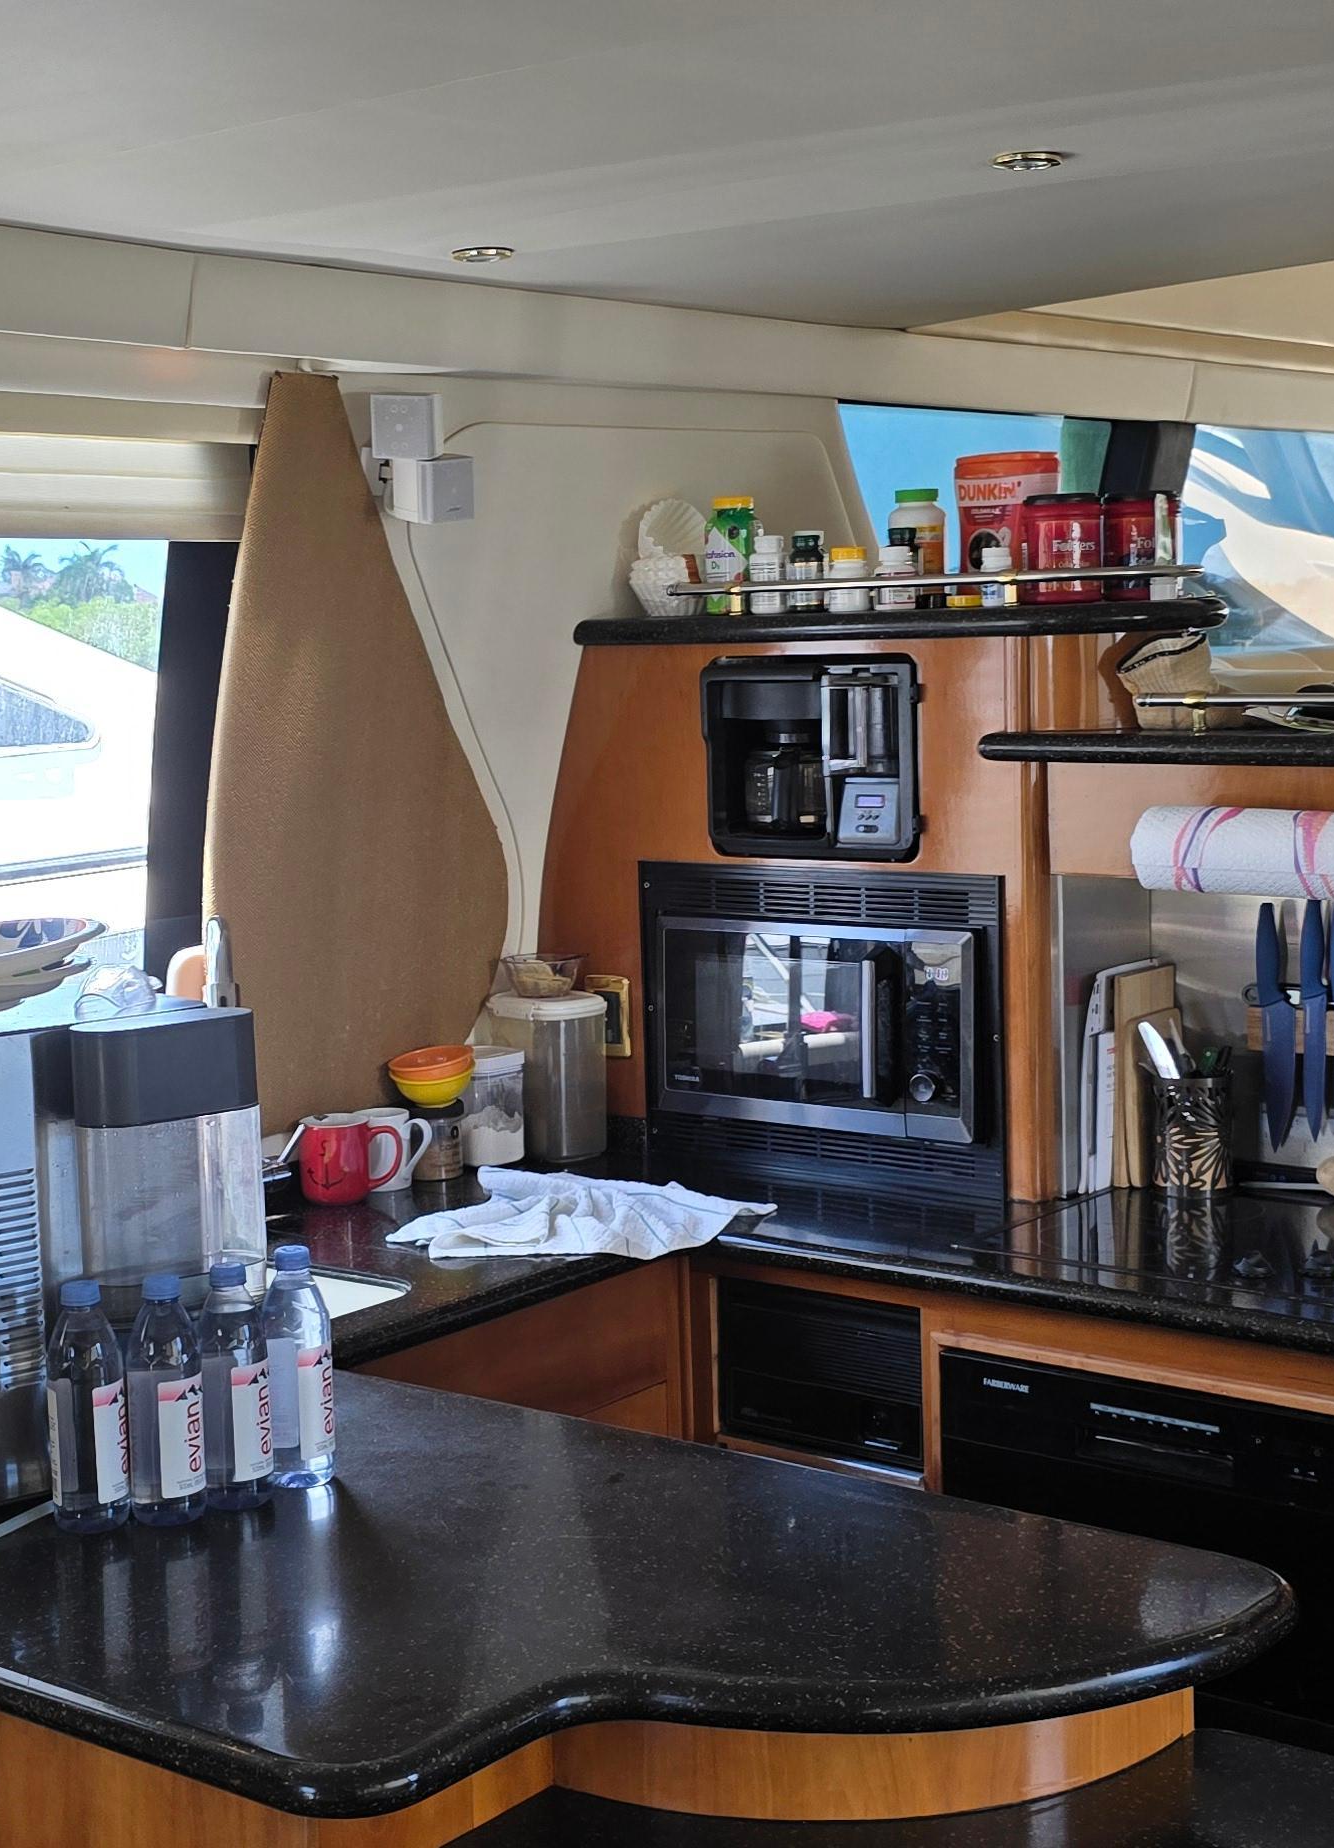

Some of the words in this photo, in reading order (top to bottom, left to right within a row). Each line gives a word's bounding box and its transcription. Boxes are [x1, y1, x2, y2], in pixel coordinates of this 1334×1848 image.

[256, 1383, 272, 1455] evian
[320, 1365, 333, 1435] evian
[184, 1400, 203, 1473] evian
